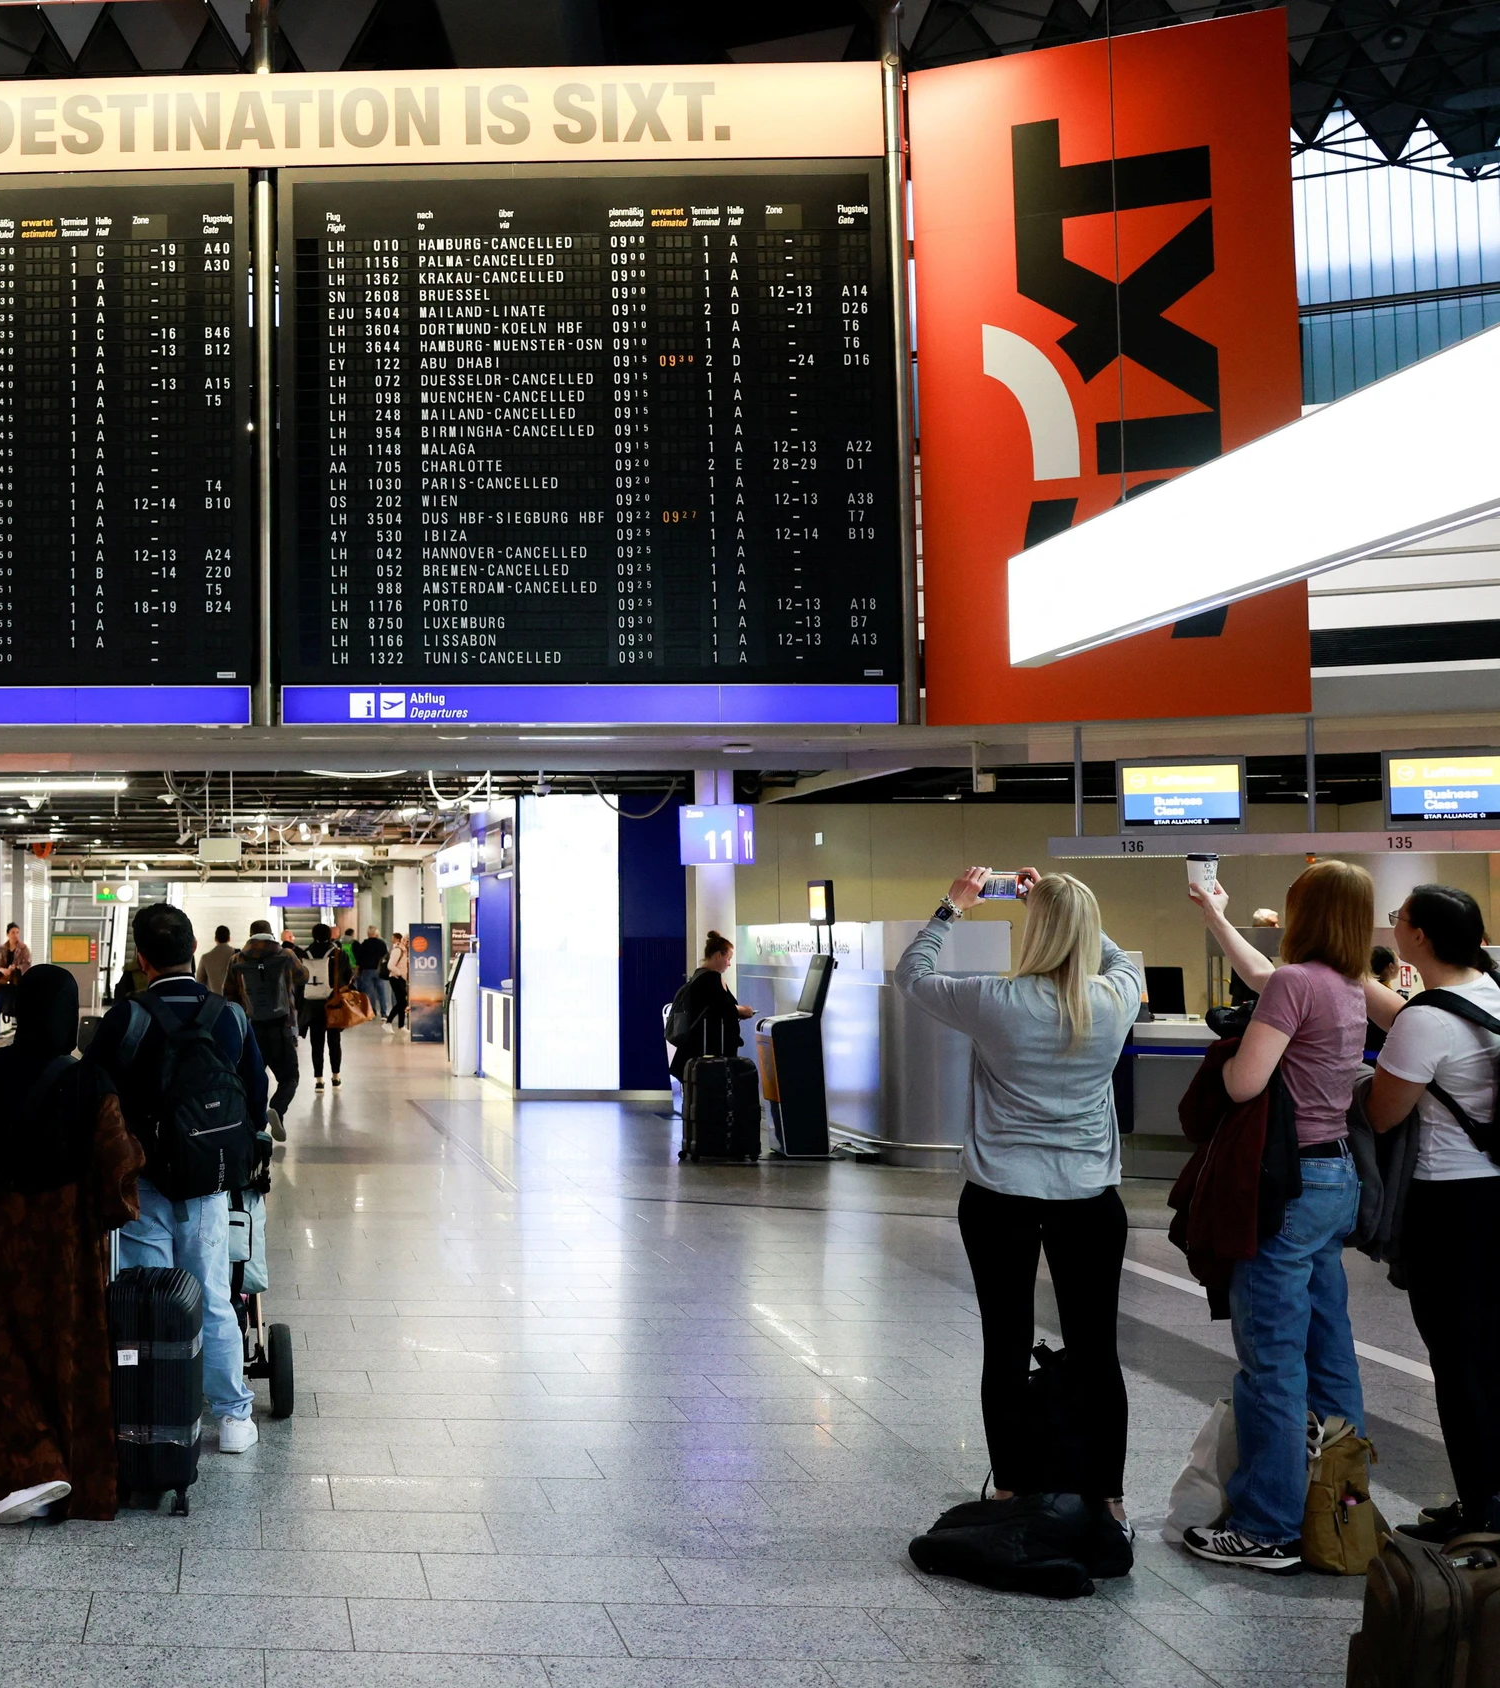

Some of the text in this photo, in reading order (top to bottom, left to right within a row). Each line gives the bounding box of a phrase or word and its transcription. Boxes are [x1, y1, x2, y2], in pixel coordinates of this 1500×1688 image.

[465, 84, 530, 146] IS
[553, 80, 731, 145] SIXT.
[21, 218, 54, 227] erwartet
[60, 217, 88, 226] Terminal
[95, 216, 112, 225] Halle
[132, 216, 149, 225] Zone
[203, 214, 233, 225] Flugsteig
[21, 228, 57, 238] estimated
[61, 228, 89, 237] Terminal
[96, 227, 110, 237] Hall
[203, 225, 219, 234] Gate
[204, 259, 230, 272] A30
[328, 284, 868, 303] SN 2608 BRUESSEL A14
[204, 377, 231, 390] A15
[329, 372, 594, 388] LH 072 DUESSELDR-CANCELLED
[329, 457, 863, 474] AA 705 CHARLOTTE D1
[330, 527, 875, 543] 4Y 530 IBIZA B19
[205, 600, 232, 613] B24
[331, 615, 867, 630] EN 8750 LUXEMBURG B7
[409, 692, 445, 706] Abflug
[409, 707, 469, 720] Departures
[1153, 796, 1203, 806] Business
[1423, 789, 1479, 800] Business
[1153, 806, 1185, 816] Class
[1423, 800, 1458, 810] Class
[704, 830, 733, 860] 11
[1121, 840, 1144, 853] 136
[1387, 836, 1413, 849] 135
